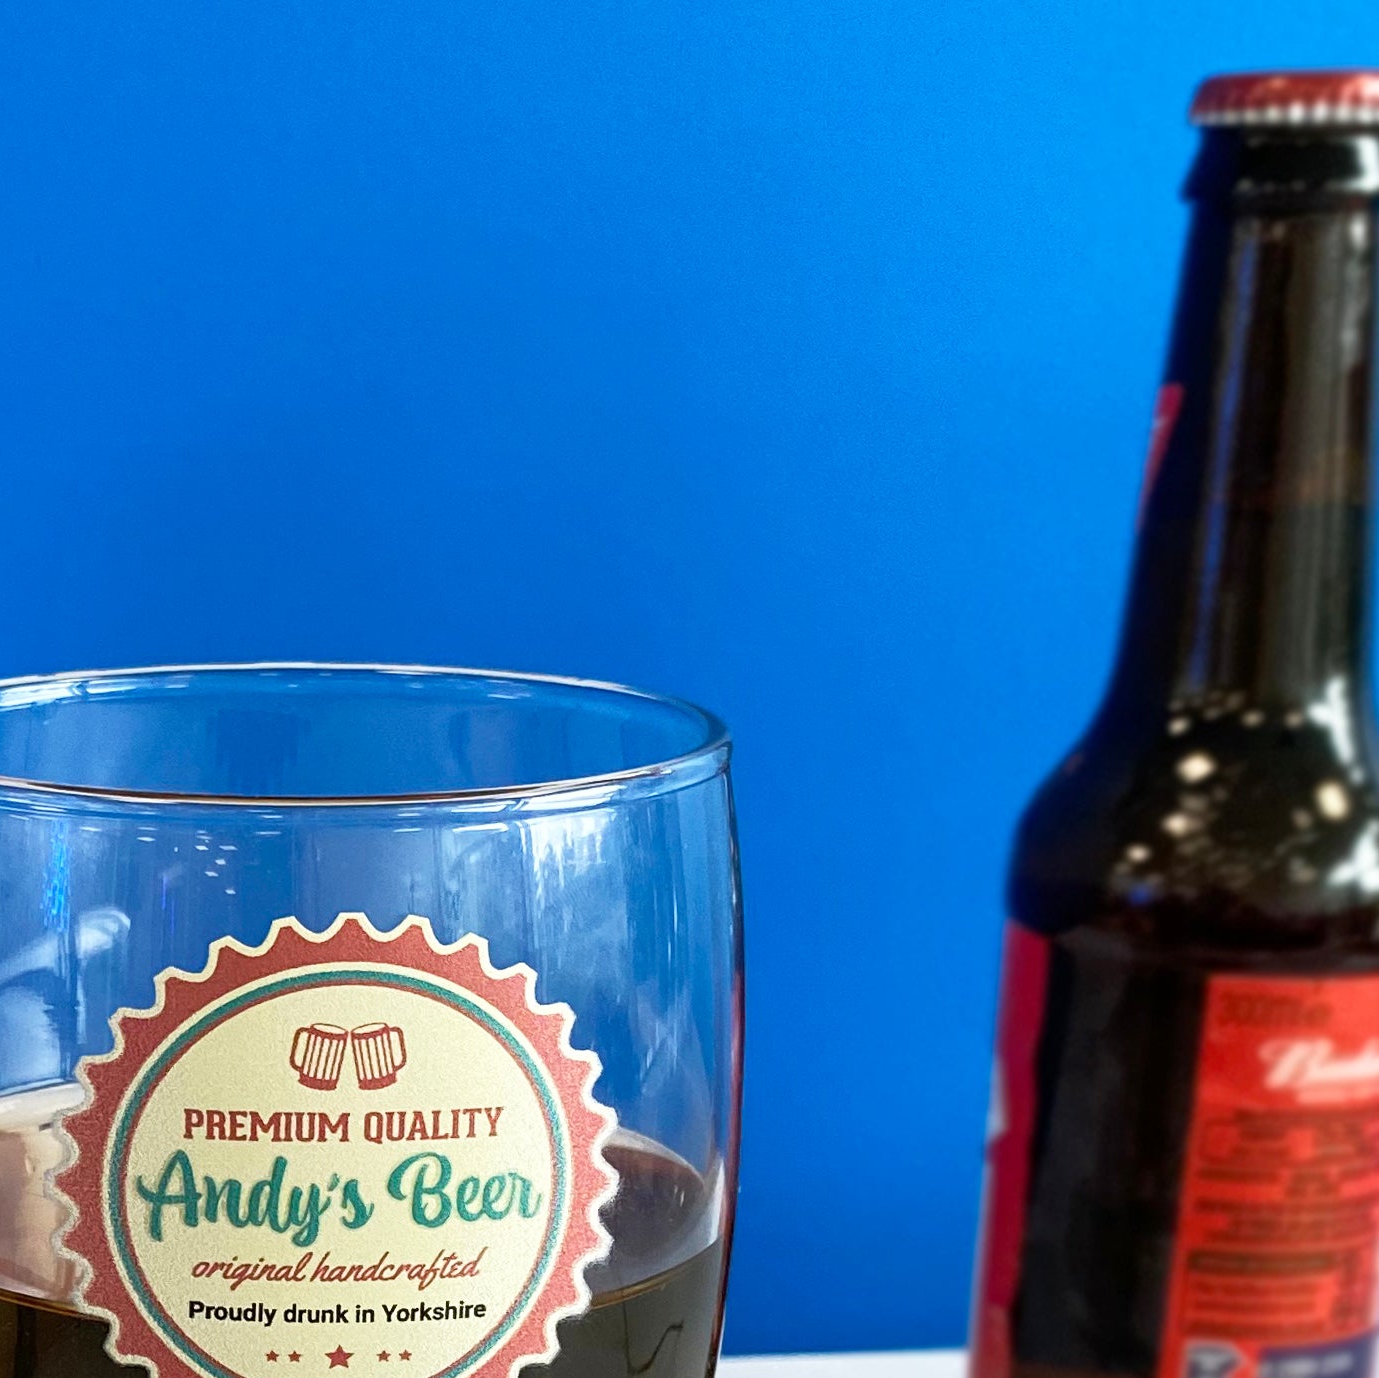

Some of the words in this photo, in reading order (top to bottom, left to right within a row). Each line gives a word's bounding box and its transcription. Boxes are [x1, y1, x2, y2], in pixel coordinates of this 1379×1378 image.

[183, 1108, 351, 1143] PREMIUM
[363, 1106, 506, 1144] QUALITY
[136, 1149, 374, 1247] Andy's
[388, 1151, 542, 1229] Beer
[191, 1251, 313, 1291] original
[310, 1247, 489, 1290] handcrafted
[188, 1300, 277, 1327] Proudly
[283, 1303, 349, 1324] drunk
[355, 1303, 375, 1324] in
[382, 1300, 487, 1323] Yorkshire
